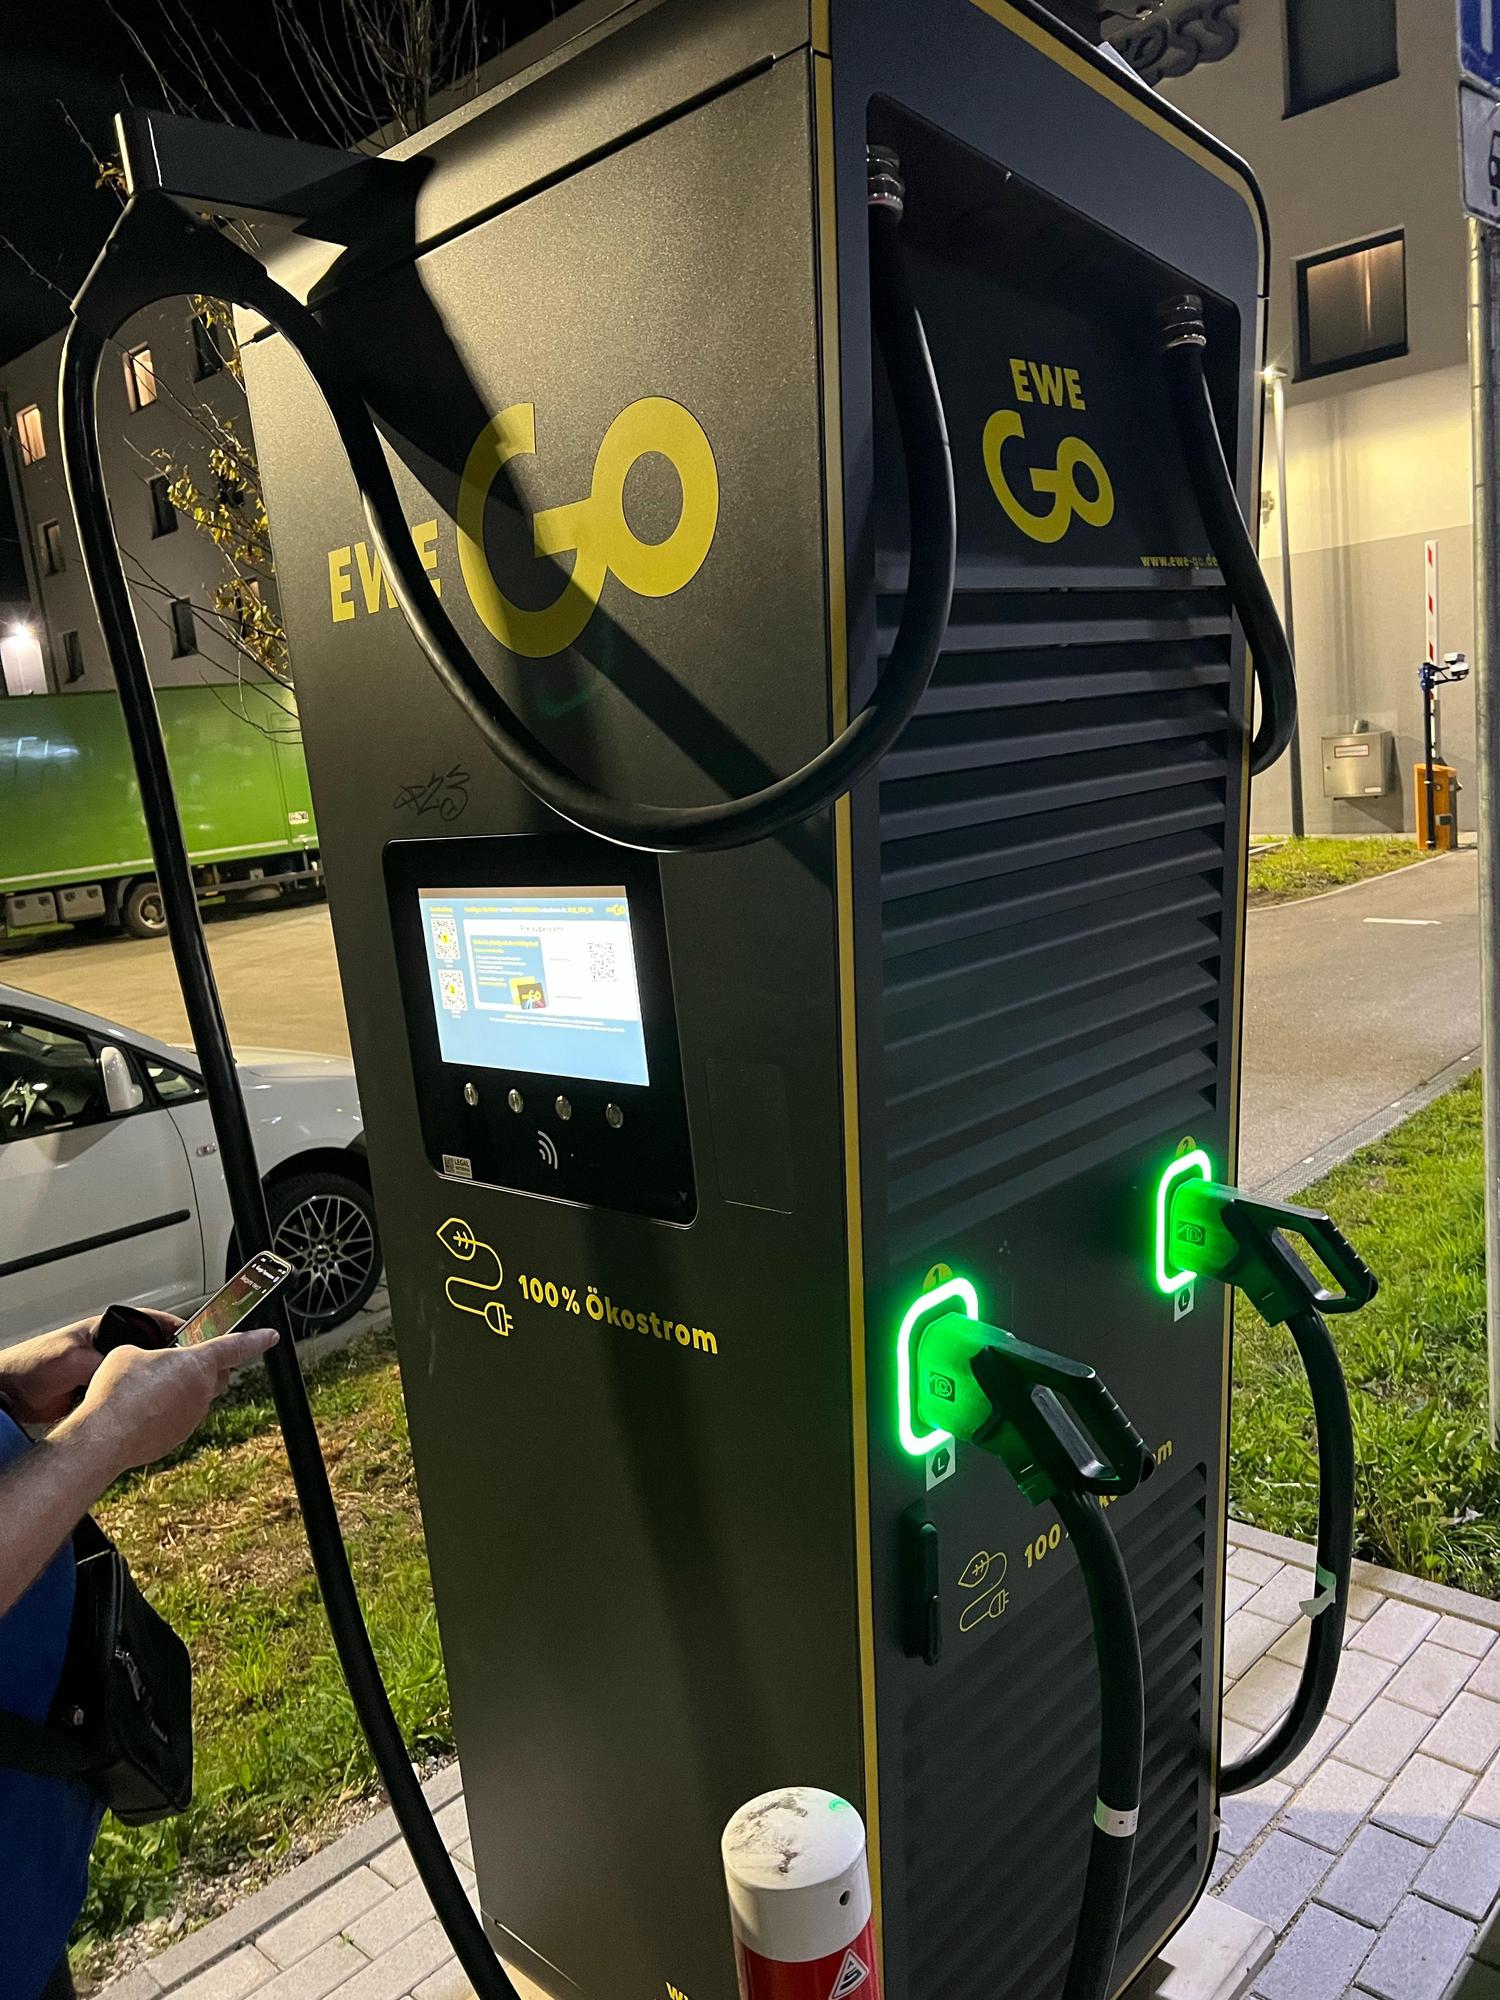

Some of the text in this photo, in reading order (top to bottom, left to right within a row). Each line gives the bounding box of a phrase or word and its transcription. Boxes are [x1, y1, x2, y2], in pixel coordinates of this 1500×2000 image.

[1009, 358, 1086, 411] EWE
[982, 409, 1115, 544] Go
[456, 395, 720, 659] Go
[1140, 553, 1218, 570] www.ewe-go.de
[585, 1285, 718, 1354] Ökostrom
[1024, 1523, 1069, 1568] 100
